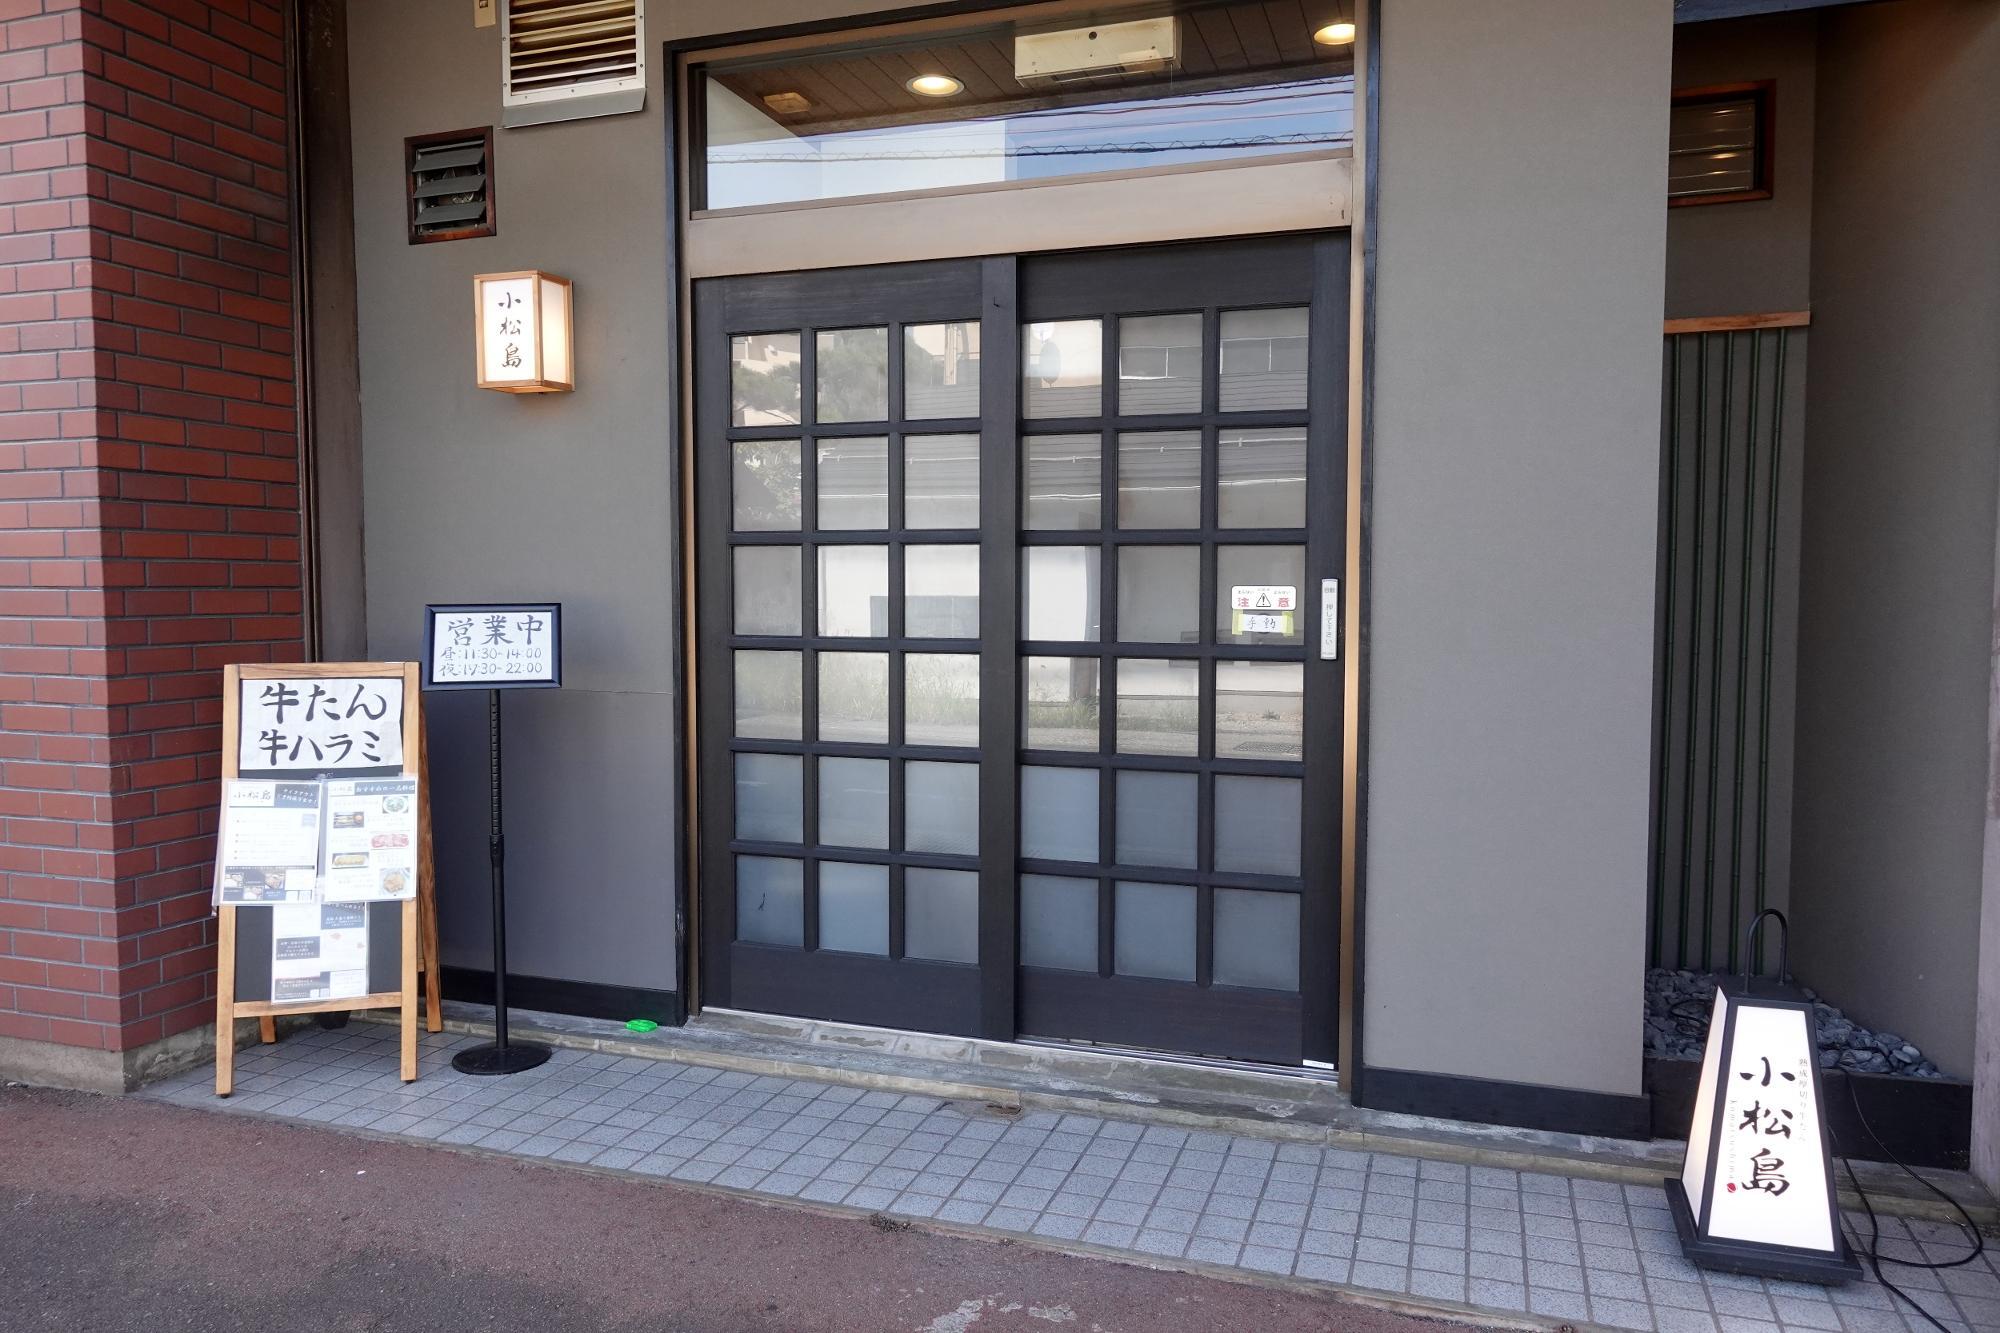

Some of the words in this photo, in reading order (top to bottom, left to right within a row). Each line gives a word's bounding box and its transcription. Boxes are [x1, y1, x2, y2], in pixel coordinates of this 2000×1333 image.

[498, 292, 521, 367] 小松島
[448, 615, 543, 645] 営業中
[260, 683, 387, 724] 牛たん
[259, 729, 381, 766] 牛ハラミ
[1739, 1056, 1795, 1196] 小松島
